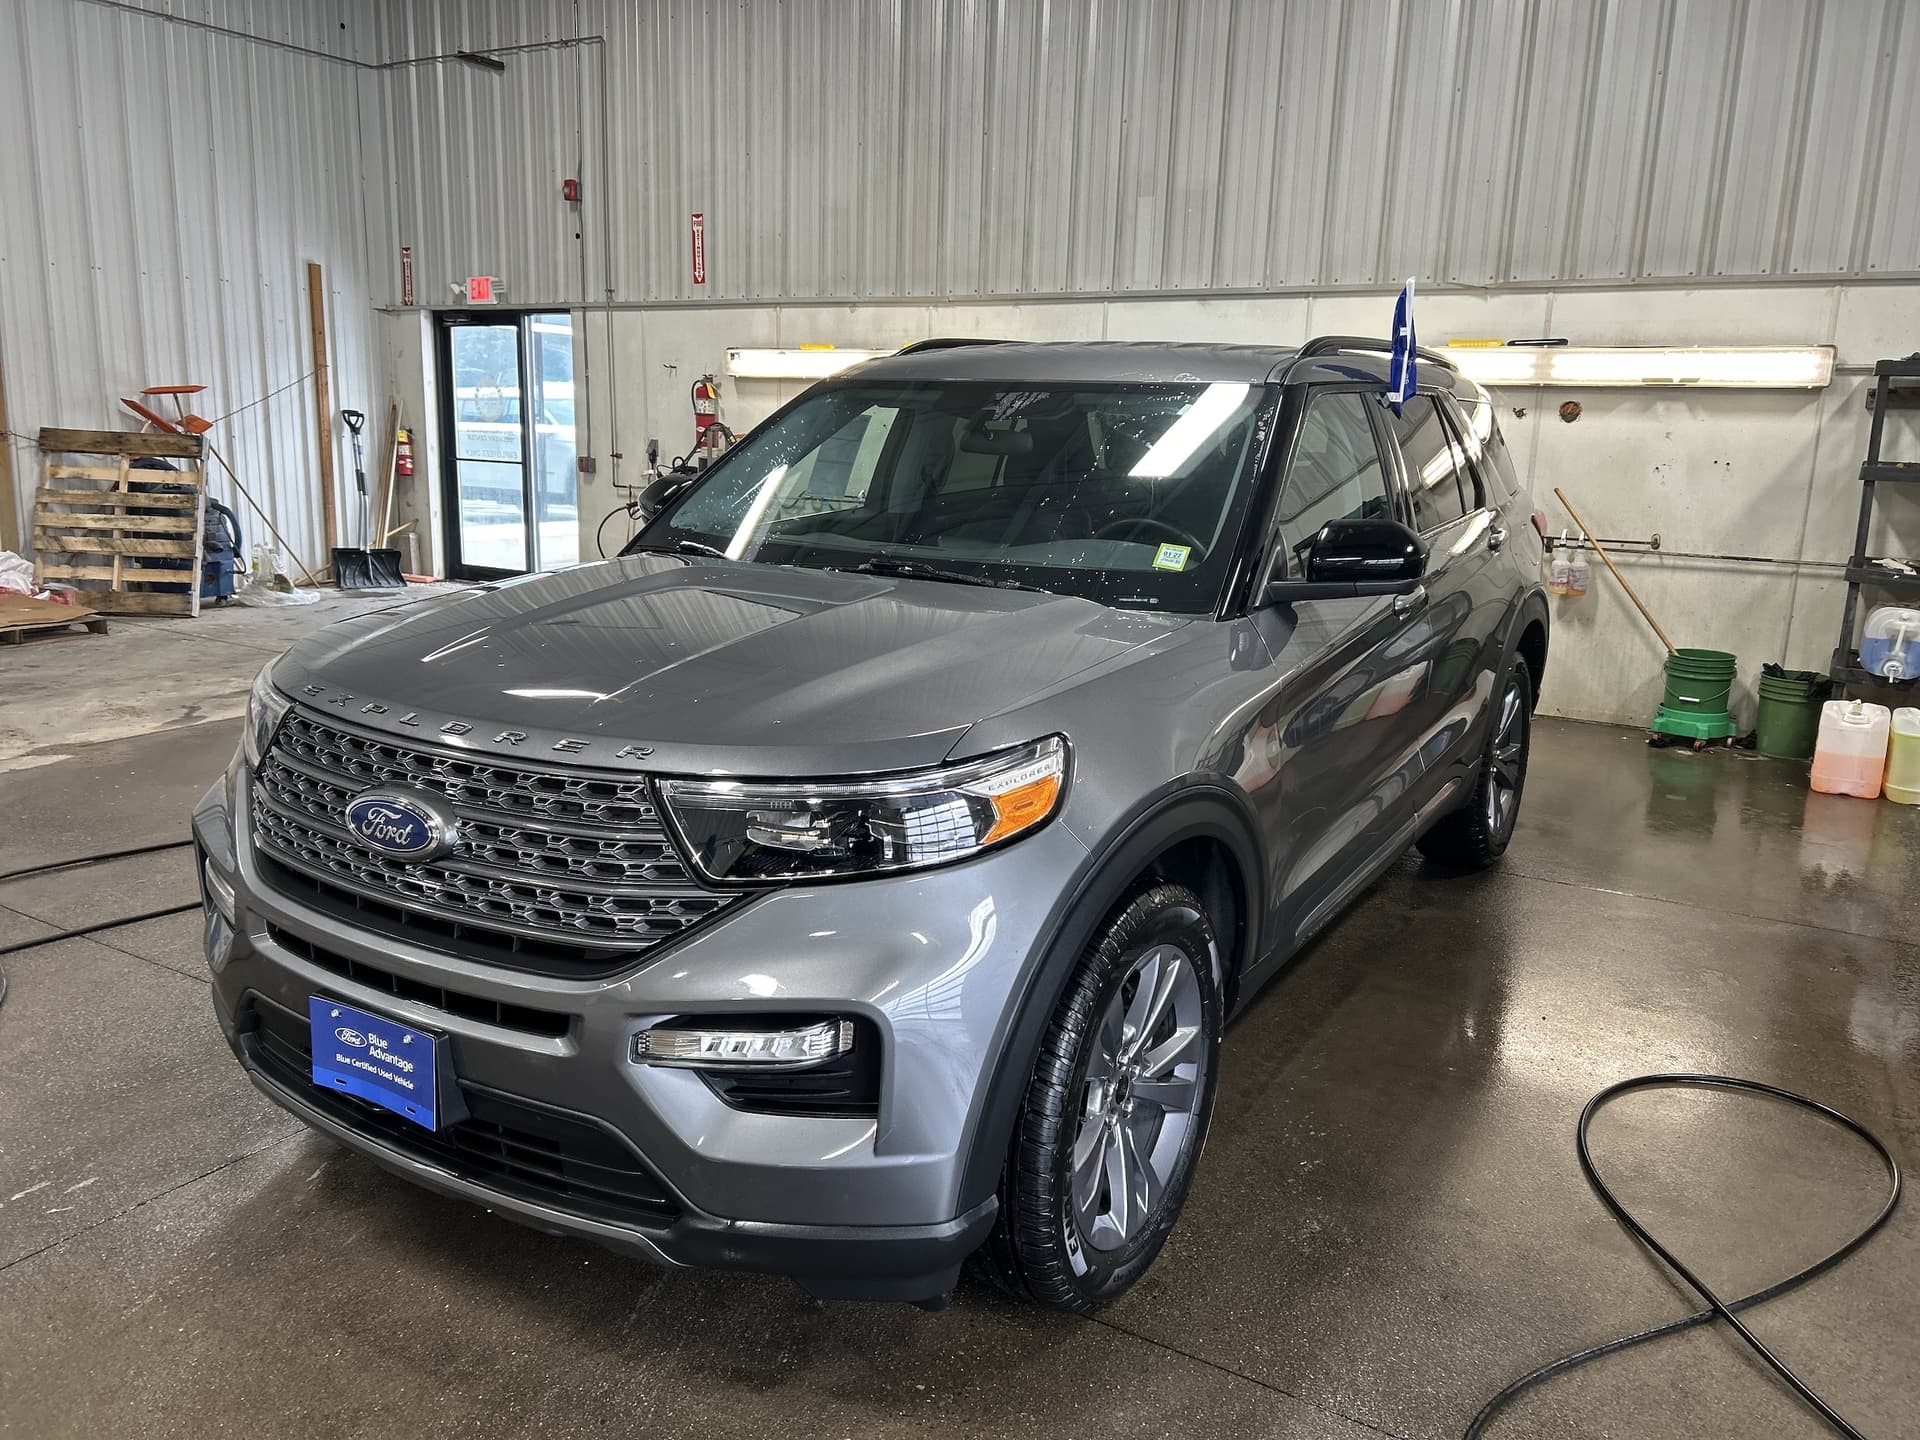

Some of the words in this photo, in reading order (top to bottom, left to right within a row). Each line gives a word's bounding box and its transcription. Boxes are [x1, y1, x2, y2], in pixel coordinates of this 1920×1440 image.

[303, 684, 655, 761] EXPLORER
[988, 763, 1051, 791] EXPLORER
[361, 807, 411, 846] Ford
[341, 1029, 362, 1045] Ford
[368, 1032, 388, 1049] Blue
[336, 1053, 351, 1065] Blue
[351, 1058, 377, 1074] Certified
[377, 1067, 393, 1080] Used
[393, 1074, 414, 1090] Vehicle
[369, 1046, 414, 1073] Advantage
